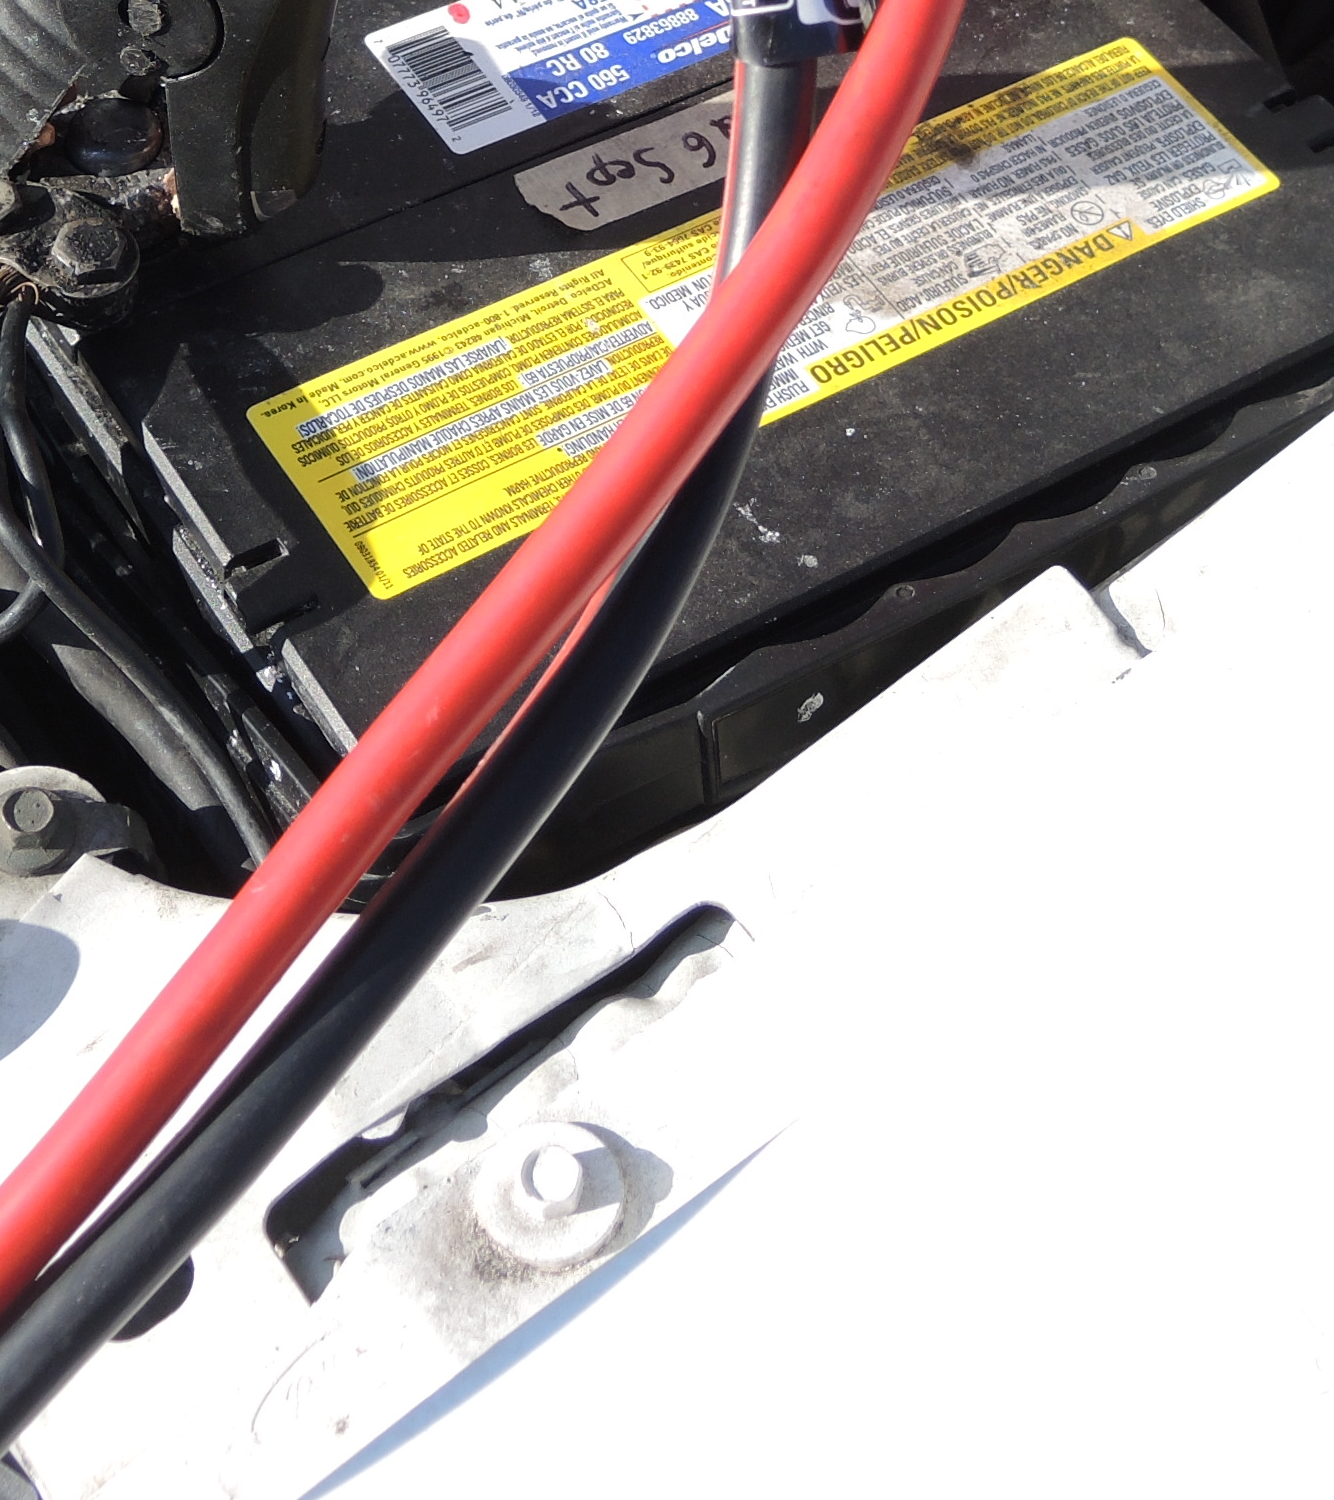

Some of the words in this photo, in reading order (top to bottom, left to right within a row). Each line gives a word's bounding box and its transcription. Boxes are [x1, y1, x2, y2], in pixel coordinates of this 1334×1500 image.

[620, 7, 700, 44] 88863829
[577, 41, 610, 62] 80
[543, 53, 580, 76] RC
[584, 63, 631, 91] 560
[535, 79, 590, 110] CCA
[413, 89, 450, 124] 96497
[1139, 98, 1185, 124] PROTEJA
[1121, 116, 1144, 131] LOS
[1063, 136, 1099, 157] GASES
[1165, 130, 1216, 157] PROTEGER
[1147, 150, 1171, 165] LES
[560, 147, 675, 218] Sept
[1102, 169, 1127, 186] GAZ
[1148, 183, 1202, 212] EXPLOSIVE
[1169, 196, 1207, 218] SHIELD
[942, 218, 985, 242] L'ACIDE
[687, 246, 710, 260] CAS
[885, 233, 949, 267] SULFURIQUE
[557, 274, 590, 292] Rights
[589, 267, 606, 279] All
[690, 275, 712, 291] UN
[591, 296, 605, 307] EL
[601, 287, 625, 303] PARA
[644, 284, 692, 311] MEDICO.
[894, 293, 923, 312] ACID
[529, 296, 568, 317] Detroit,
[558, 300, 596, 321] SISTEMA
[806, 232, 1116, 386] DANGER/POISON/PELIGRO
[482, 311, 531, 337] Michigan
[579, 309, 643, 342] ACUMULADORES
[452, 332, 484, 350] 48243
[537, 335, 584, 361] CONTIENEN
[378, 358, 421, 382] General
[441, 356, 465, 373] LAS
[405, 364, 446, 389] MANOS
[456, 366, 512, 396] COMPUESTOS
[499, 379, 518, 392] LOS
[549, 359, 608, 392] LAVEZ-VOUS
[307, 381, 339, 399] Made
[340, 376, 379, 398] Motors
[444, 389, 460, 401] DE
[466, 386, 502, 407] BORNES,
[531, 384, 553, 400] LES
[259, 399, 296, 419] Korea.
[295, 394, 308, 404] In
[348, 399, 366, 414] DE
[417, 394, 449, 413] PLOMO
[498, 391, 536, 415] MAINS
[605, 399, 624, 414] DE
[294, 404, 353, 438] TOCARLOS!
[384, 409, 415, 428] OTROS
[410, 406, 421, 416] Y
[417, 400, 470, 429] TERMINALES
[581, 405, 610, 425] MISE
[411, 422, 421, 431] Y
[428, 419, 472, 446] CHAQUE
[567, 416, 586, 431] EN
[336, 420, 388, 449] PRODUCTOS
[362, 424, 415, 453] ACCESORIOS
[520, 436, 538, 450] LES
[535, 423, 572, 446] GARDE
[334, 451, 354, 466] LOS
[350, 446, 366, 458] DE
[351, 437, 433, 480] MANIPULATION!
[486, 443, 524, 466] BORNES,
[445, 472, 460, 485] ET
[456, 458, 491, 480] COSSES
[527, 452, 588, 485] REPRODUCTIVE
[392, 476, 450, 509] ACCESSOIRES
[510, 482, 558, 509] CHEMICALS
[379, 501, 396, 515] DE
[479, 502, 514, 524] KNOWN
[508, 499, 556, 527] TERMINALS
[342, 506, 384, 532] BATTERIE
[466, 517, 482, 530] TO
[490, 520, 513, 536] AND
[426, 530, 454, 549] STATE
[450, 523, 470, 538] THE
[455, 528, 494, 553] RELATED
[414, 542, 429, 555] OF
[400, 545, 459, 578] ACCESSORIES
